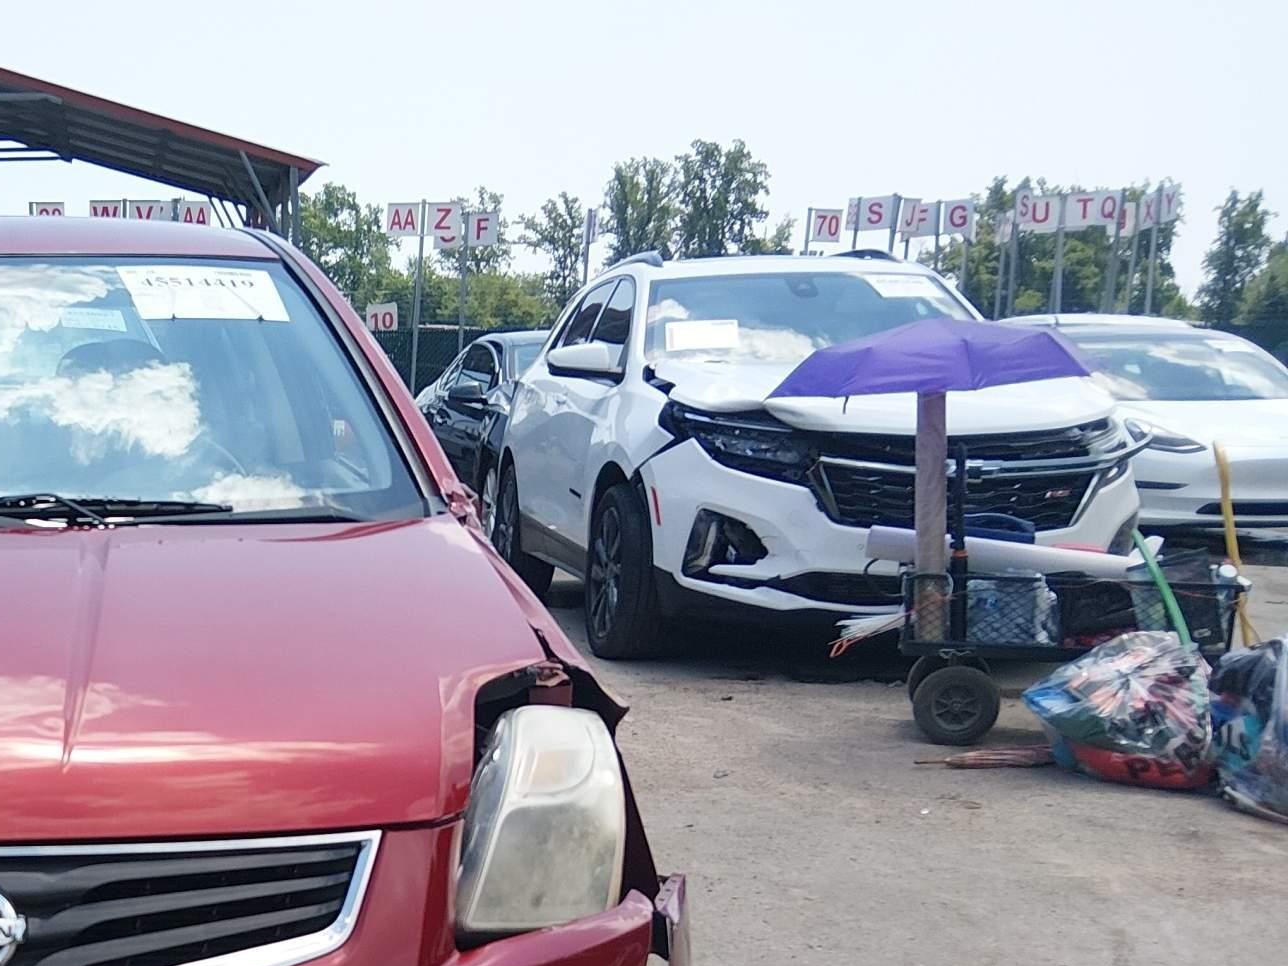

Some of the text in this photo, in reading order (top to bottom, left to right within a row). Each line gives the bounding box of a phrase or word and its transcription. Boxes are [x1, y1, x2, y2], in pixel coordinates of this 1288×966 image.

[867, 202, 883, 225] S
[1020, 194, 1031, 218] S
[1031, 201, 1050, 224] U
[1076, 198, 1095, 219] T
[1100, 196, 1117, 219] Q
[1143, 199, 1153, 223] X
[1165, 191, 1177, 215] Y
[183, 207, 207, 225] AA
[389, 208, 416, 231] AA
[434, 208, 452, 230] Z
[817, 215, 840, 237] 70
[905, 205, 916, 227] J
[949, 205, 968, 228] G
[476, 218, 490, 240] F
[141, 276, 255, 289] 45514419
[370, 312, 394, 331] 10
